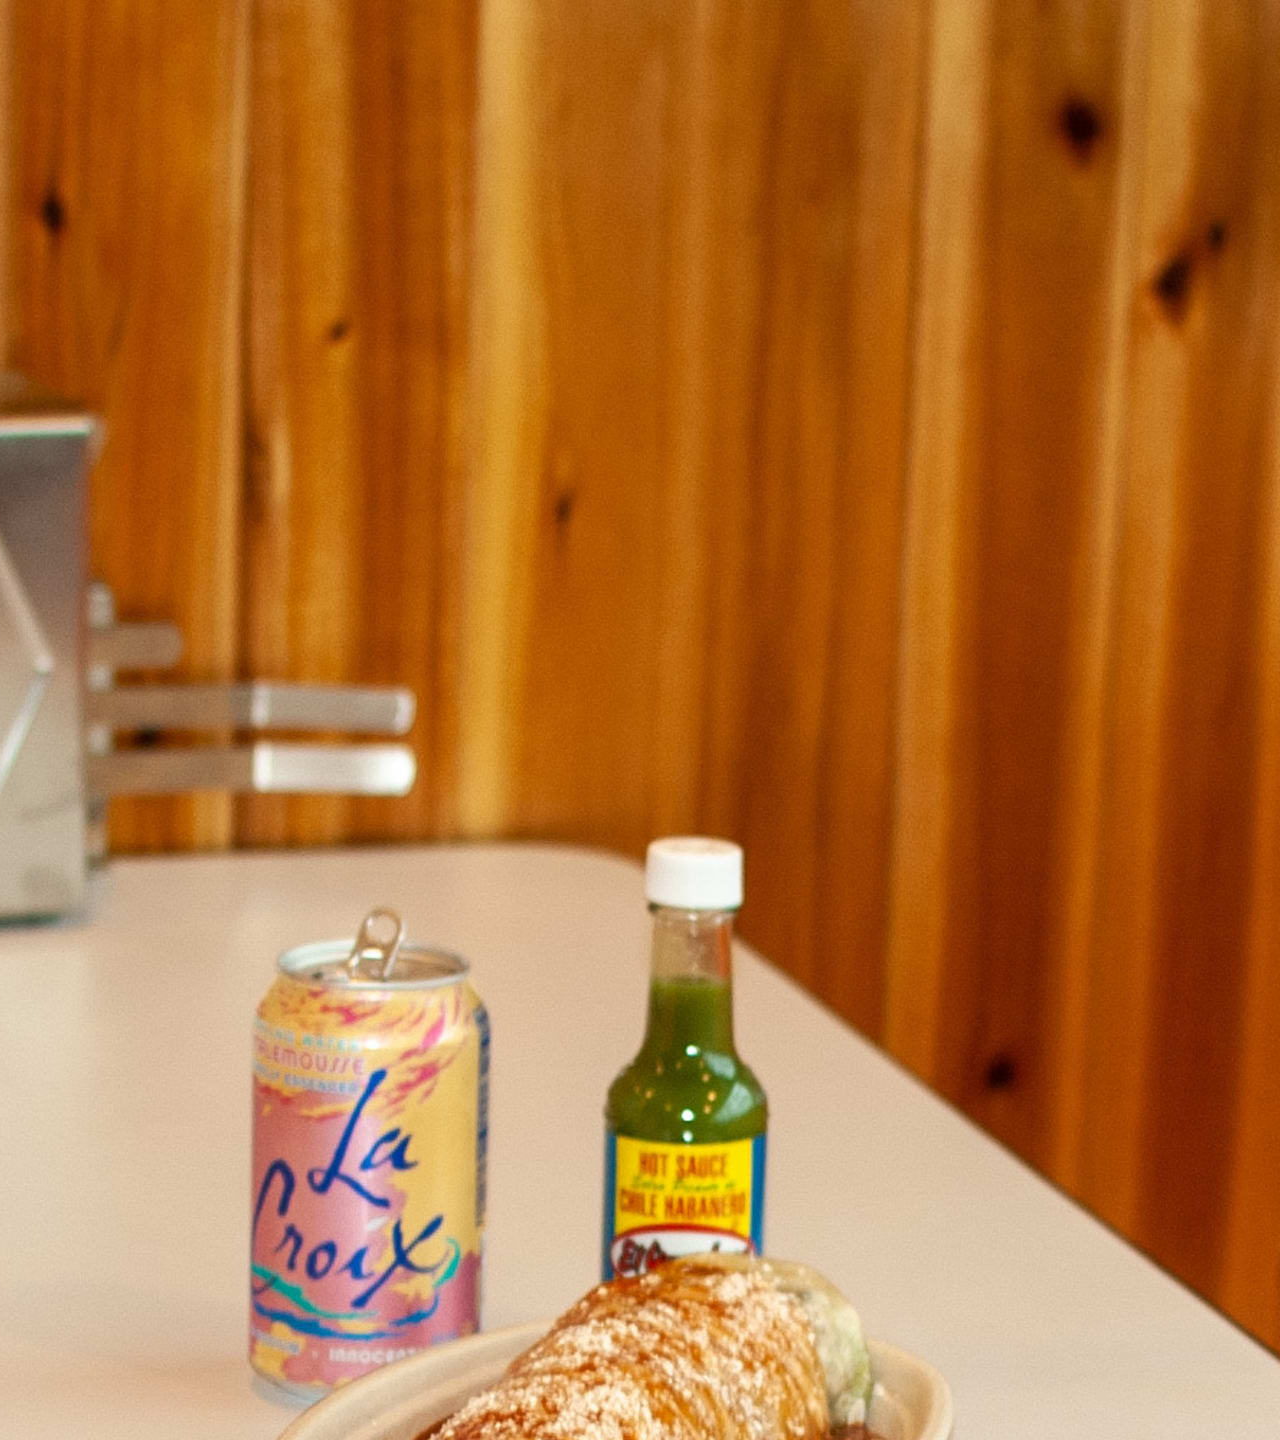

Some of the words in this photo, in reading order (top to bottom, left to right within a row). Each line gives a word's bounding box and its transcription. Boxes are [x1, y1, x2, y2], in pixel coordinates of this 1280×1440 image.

[307, 1068, 419, 1208] La
[640, 1152, 668, 1177] HOT
[676, 1154, 726, 1178] SAUCE
[249, 1158, 444, 1306] Croix
[621, 1188, 656, 1217] CHILE
[664, 1192, 745, 1219] HABANERO
